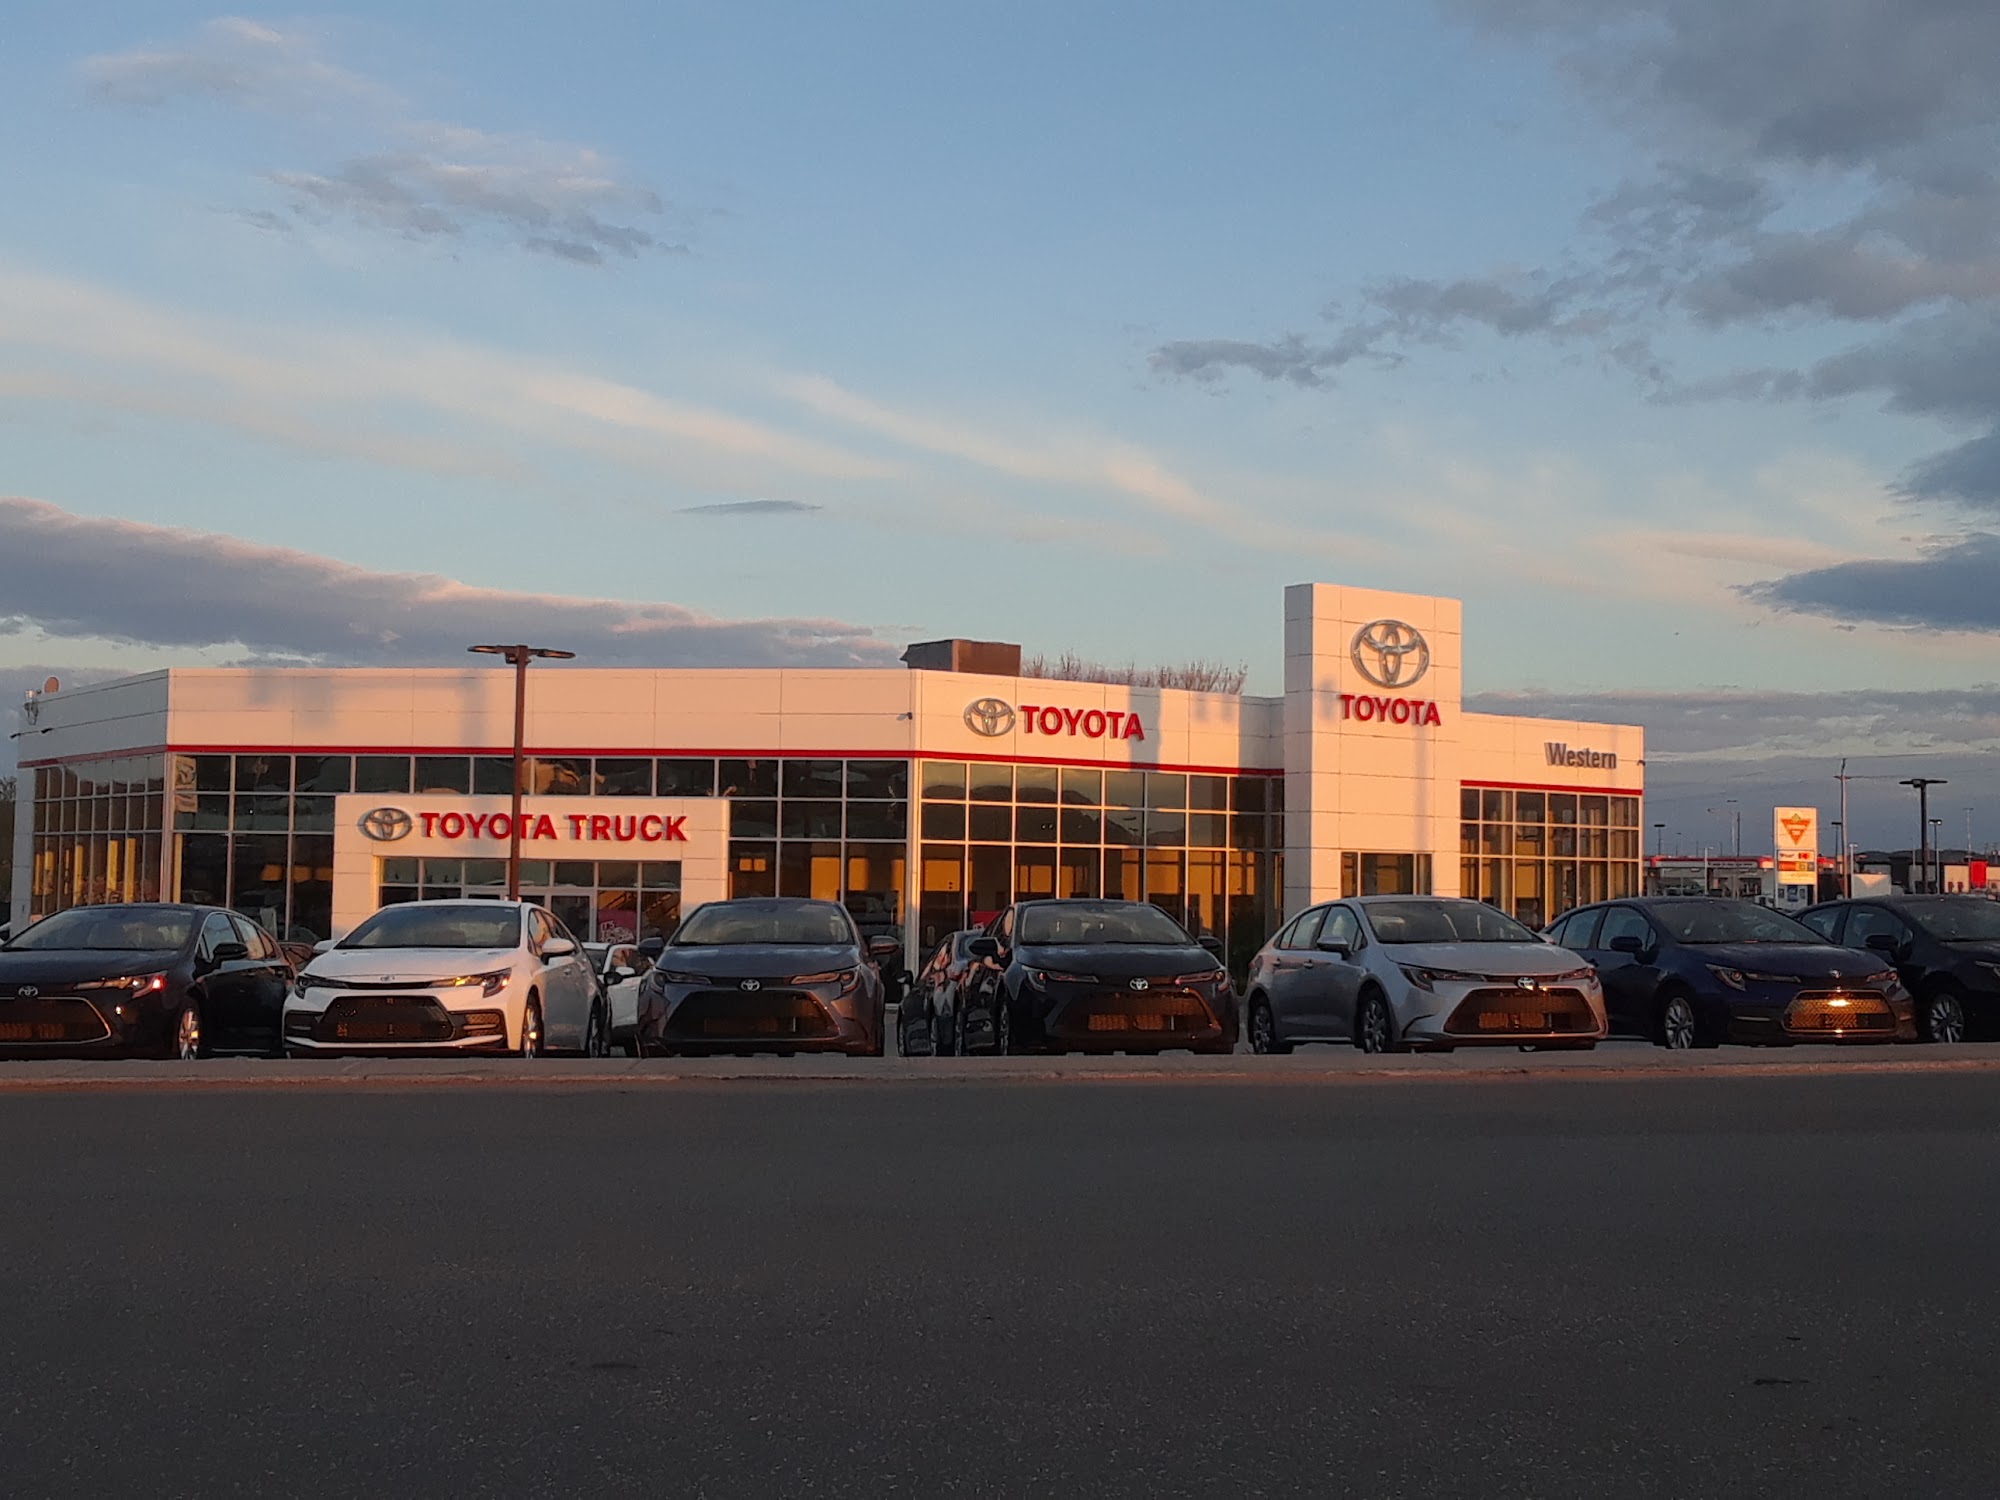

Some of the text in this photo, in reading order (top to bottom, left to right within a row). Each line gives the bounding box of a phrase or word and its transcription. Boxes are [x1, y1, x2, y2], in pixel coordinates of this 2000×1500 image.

[1020, 705, 1144, 741] TOYOTA
[1340, 694, 1441, 727] TOYOTA
[1545, 742, 1617, 769] Western
[420, 812, 688, 842] TOYOTA TRUCK
